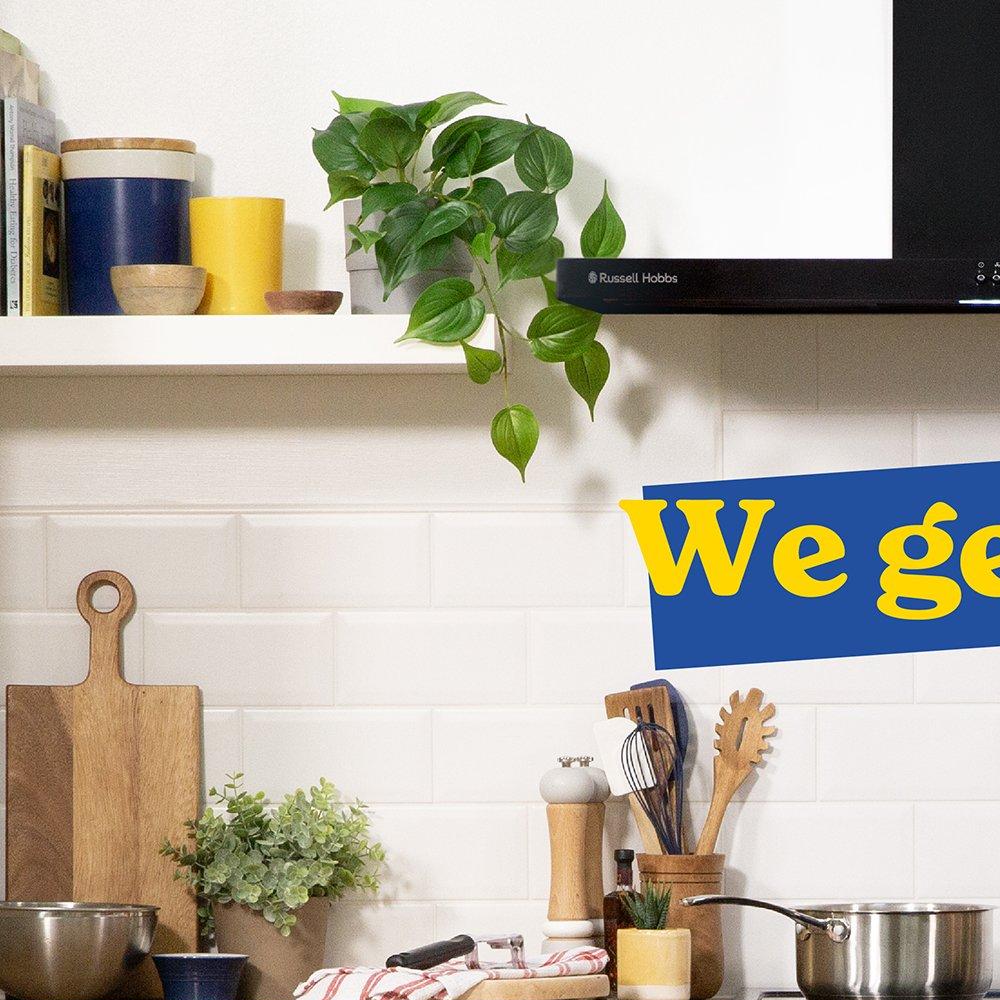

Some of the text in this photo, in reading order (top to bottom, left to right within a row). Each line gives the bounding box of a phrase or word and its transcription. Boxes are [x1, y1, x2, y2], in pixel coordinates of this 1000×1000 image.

[8, 178, 18, 284] Healthy Eating for Diabetes
[599, 272, 678, 283] Russell Hobbs
